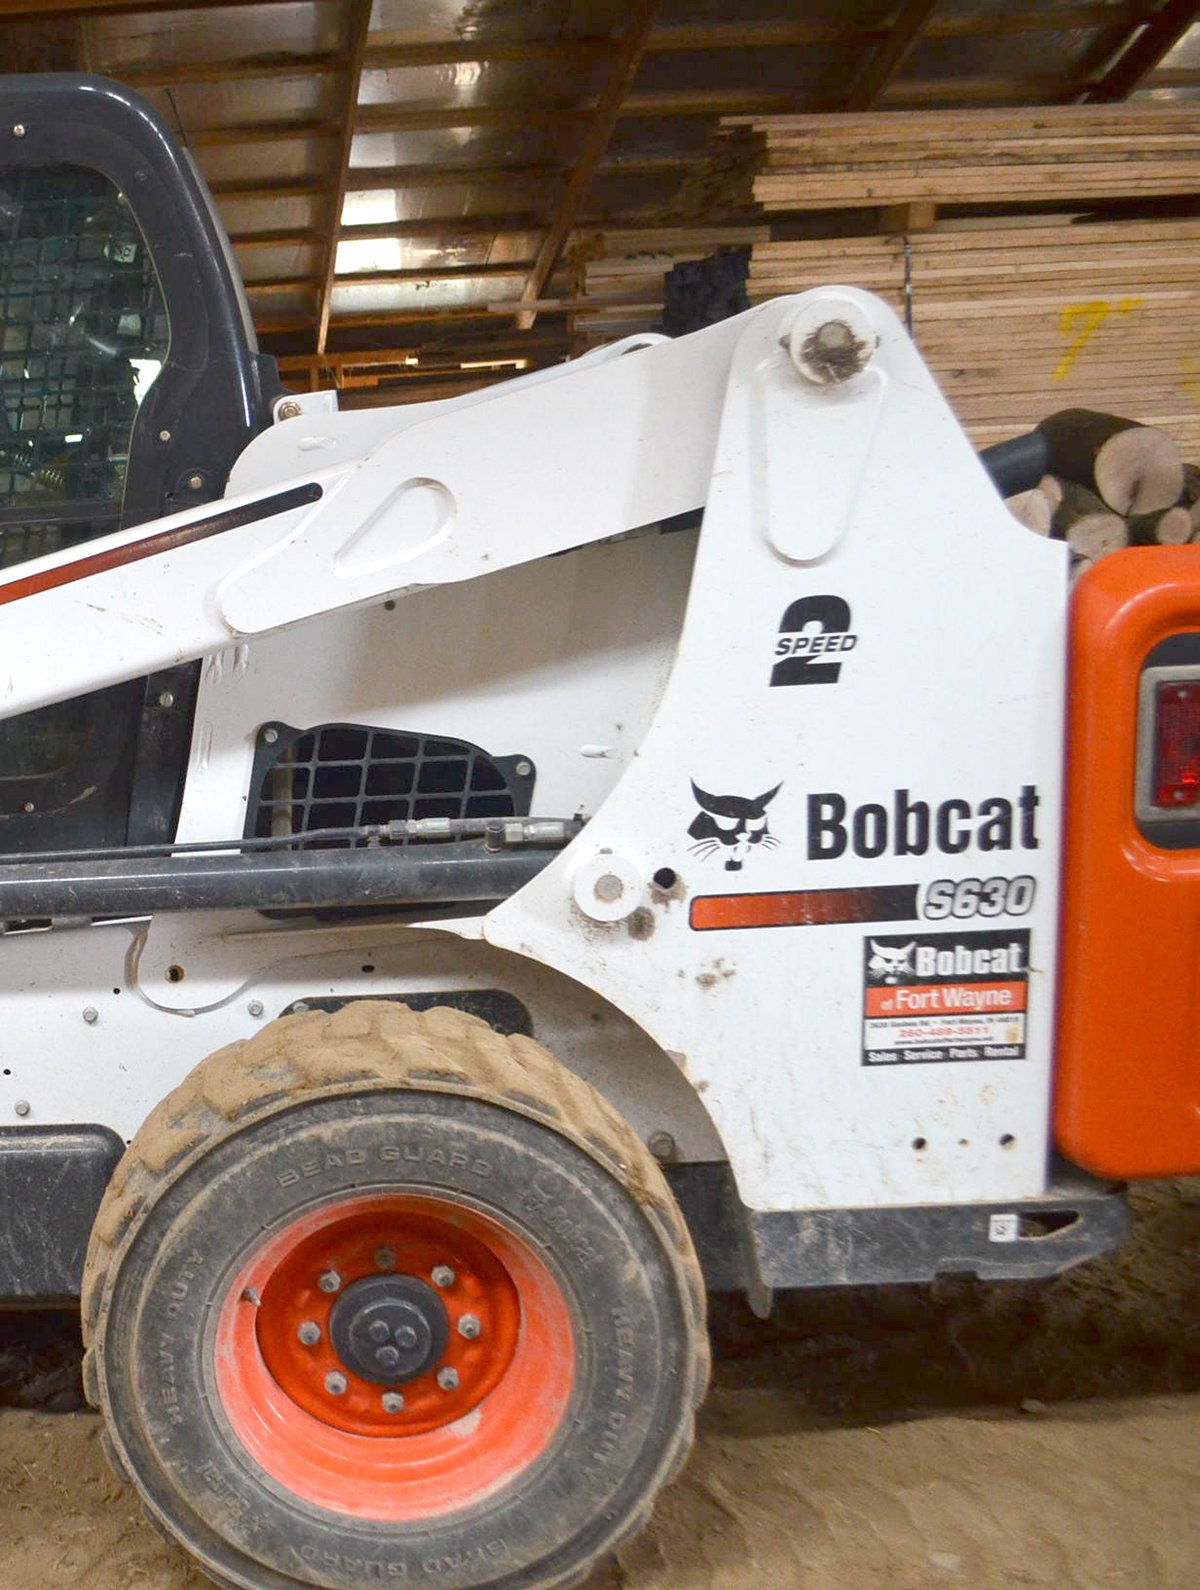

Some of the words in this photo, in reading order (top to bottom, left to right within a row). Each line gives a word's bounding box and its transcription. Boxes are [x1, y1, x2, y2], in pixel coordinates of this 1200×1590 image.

[769, 594, 852, 688] 2
[774, 633, 858, 657] SPEED
[806, 784, 1040, 861] Bobcat
[923, 875, 1037, 921] S630
[916, 942, 1022, 977] Bobcat
[880, 997, 894, 1011] of
[896, 988, 940, 1010] Fort
[941, 987, 1013, 1011] Wayne
[868, 1051, 898, 1062] Sales
[903, 1049, 943, 1060] Service
[949, 1047, 979, 1058] Parts
[984, 1045, 1020, 1056] Rental
[277, 1148, 368, 1189] BEAD
[379, 1145, 494, 1180] GUARD
